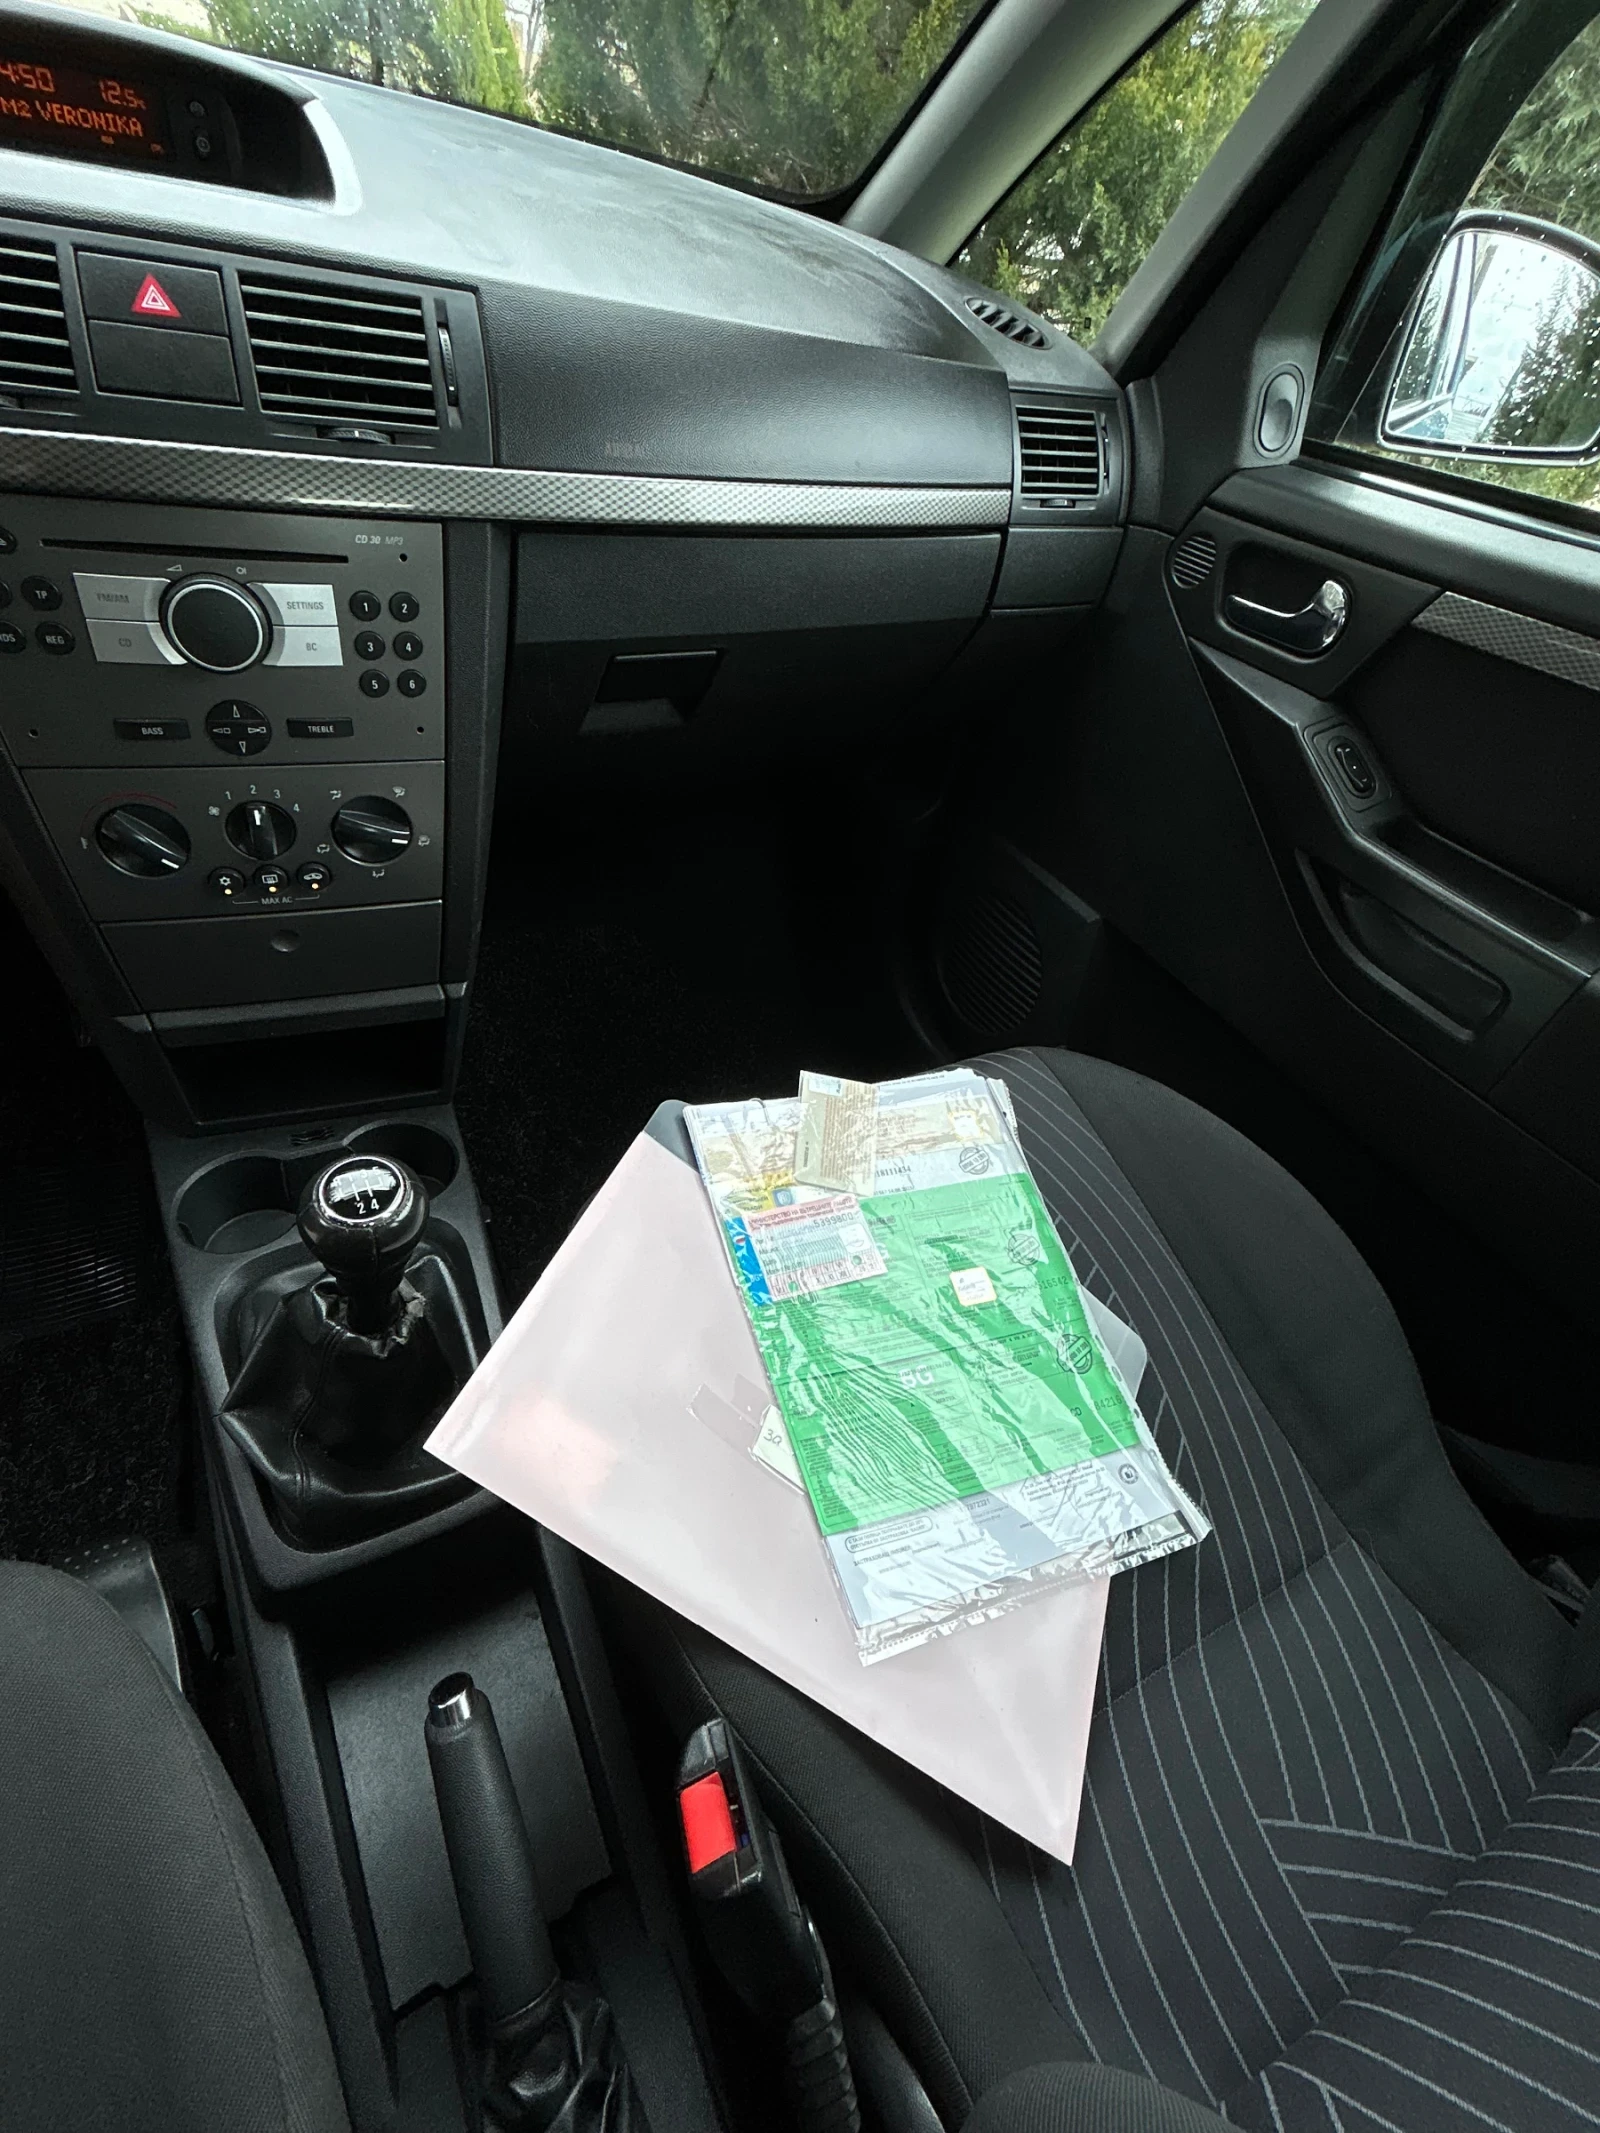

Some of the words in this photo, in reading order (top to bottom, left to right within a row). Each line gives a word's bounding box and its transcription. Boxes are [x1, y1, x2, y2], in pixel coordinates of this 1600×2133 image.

[35, 100, 143, 137] VERONIKA
[355, 534, 369, 544] CD
[370, 535, 381, 545] 30
[385, 536, 404, 546] MP3
[35, 590, 48, 600] TP
[286, 601, 325, 610] SETTINGS
[363, 602, 369, 613] 1
[401, 603, 408, 614] 2
[45, 635, 65, 645] REG
[118, 637, 132, 648] CD
[305, 642, 318, 652] BC
[367, 642, 374, 652] 3
[405, 642, 412, 652] 4
[371, 680, 379, 690] 5
[409, 680, 416, 690] 6
[141, 727, 164, 736] BASS
[307, 725, 335, 734] TREBLE
[225, 791, 232, 800] 1
[250, 784, 257, 794] 2
[273, 789, 281, 799] 3
[293, 803, 300, 812] 4
[261, 897, 280, 905] MAX
[281, 896, 294, 904] AC
[357, 1202, 366, 1214] 2
[370, 1198, 379, 1210] 4
